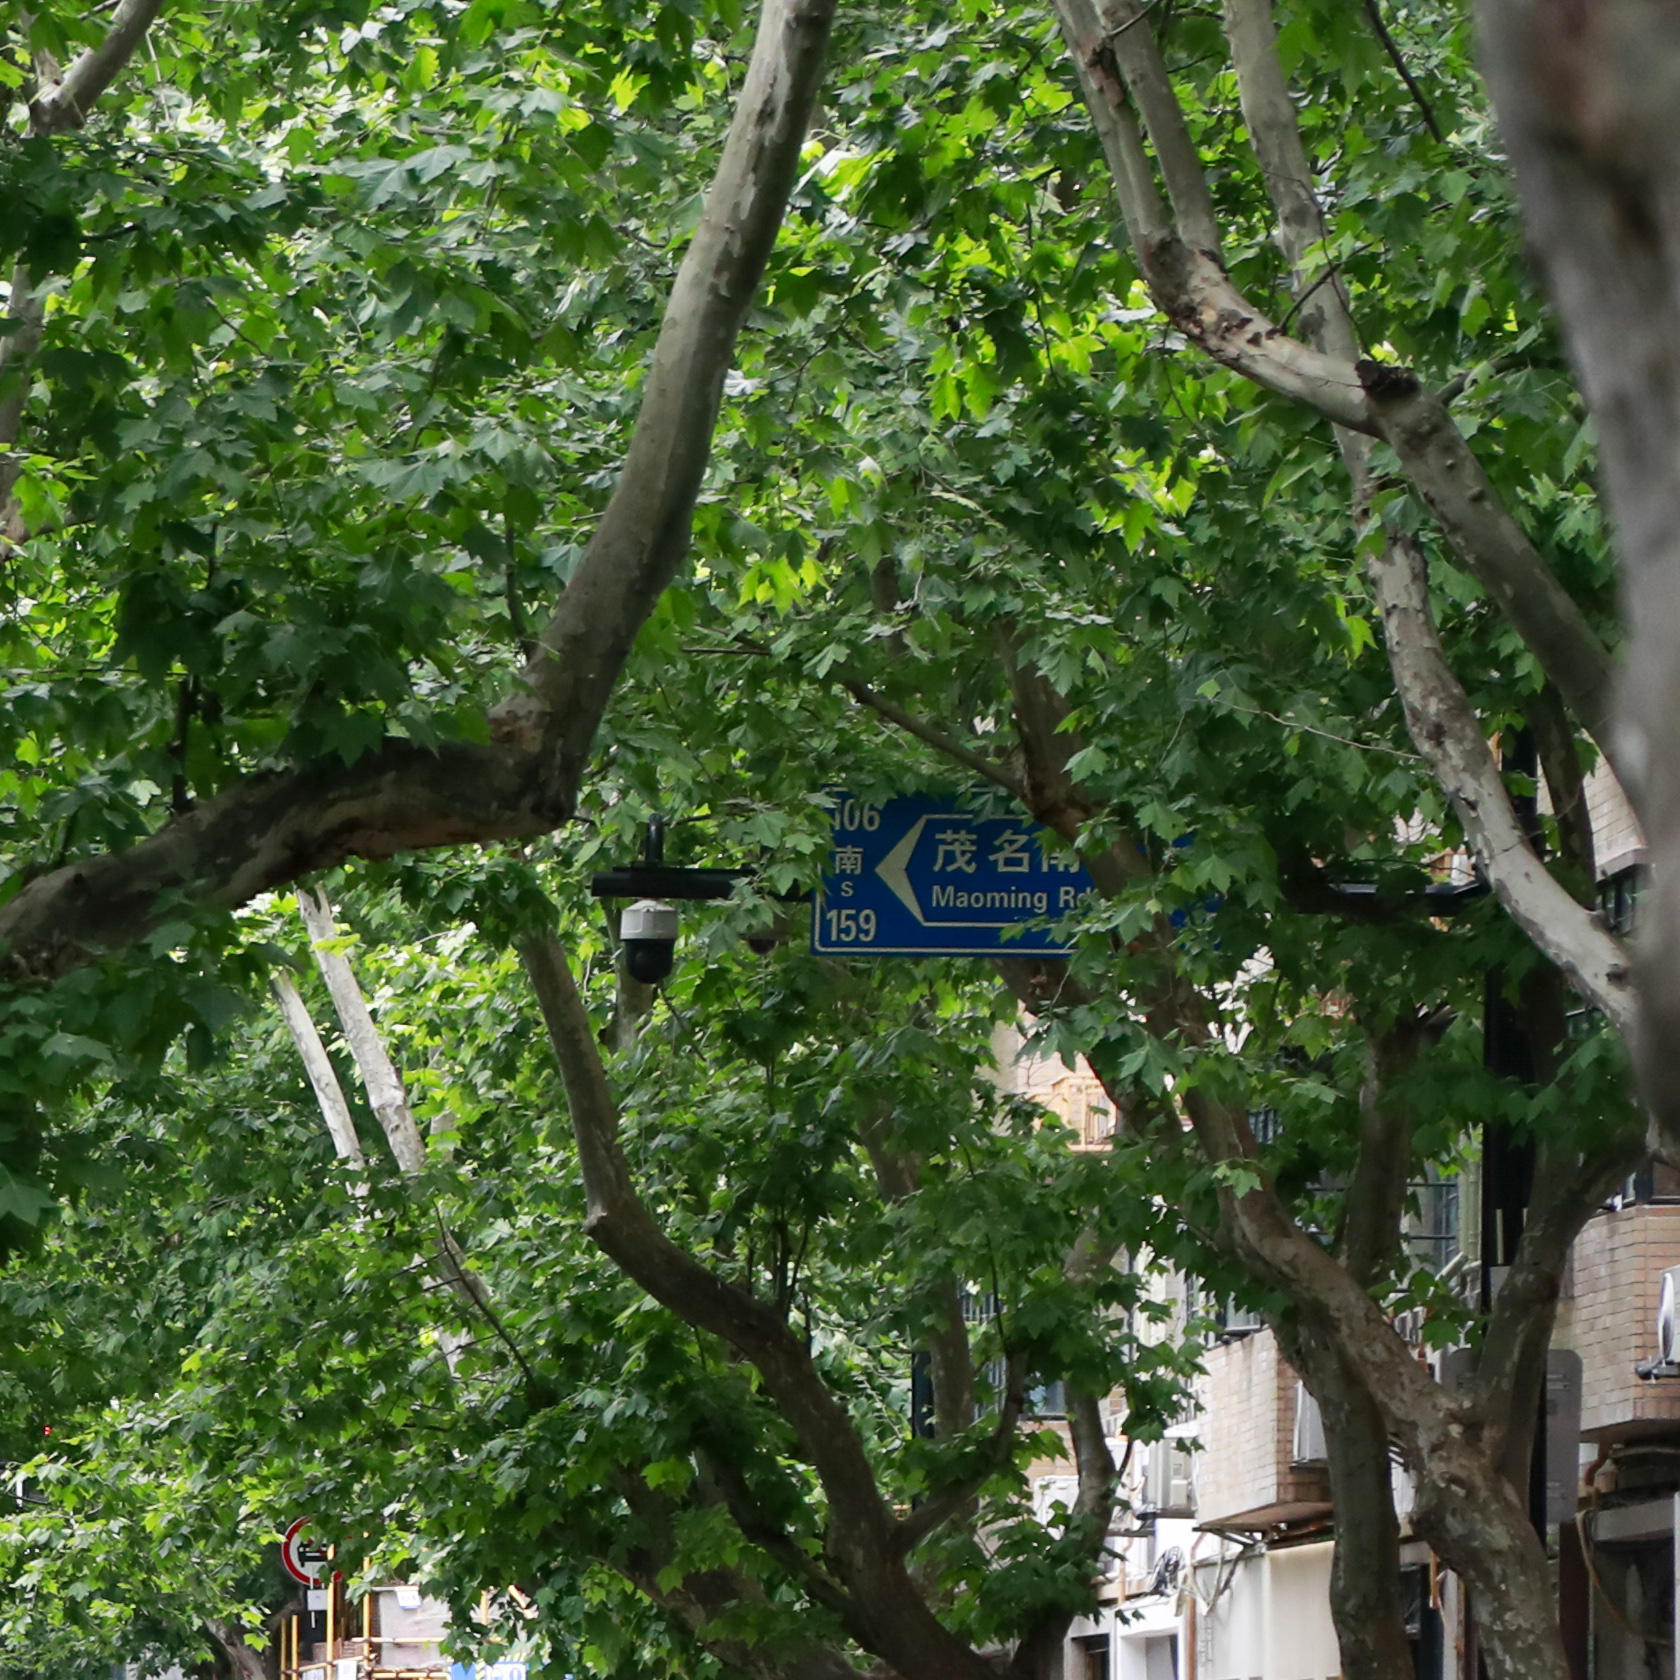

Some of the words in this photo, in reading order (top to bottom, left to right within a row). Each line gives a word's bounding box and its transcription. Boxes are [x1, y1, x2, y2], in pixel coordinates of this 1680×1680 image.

[835, 845, 863, 875] 南
[840, 881, 854, 897] S
[931, 885, 1048, 913] Maoming
[826, 909, 877, 942] 159
